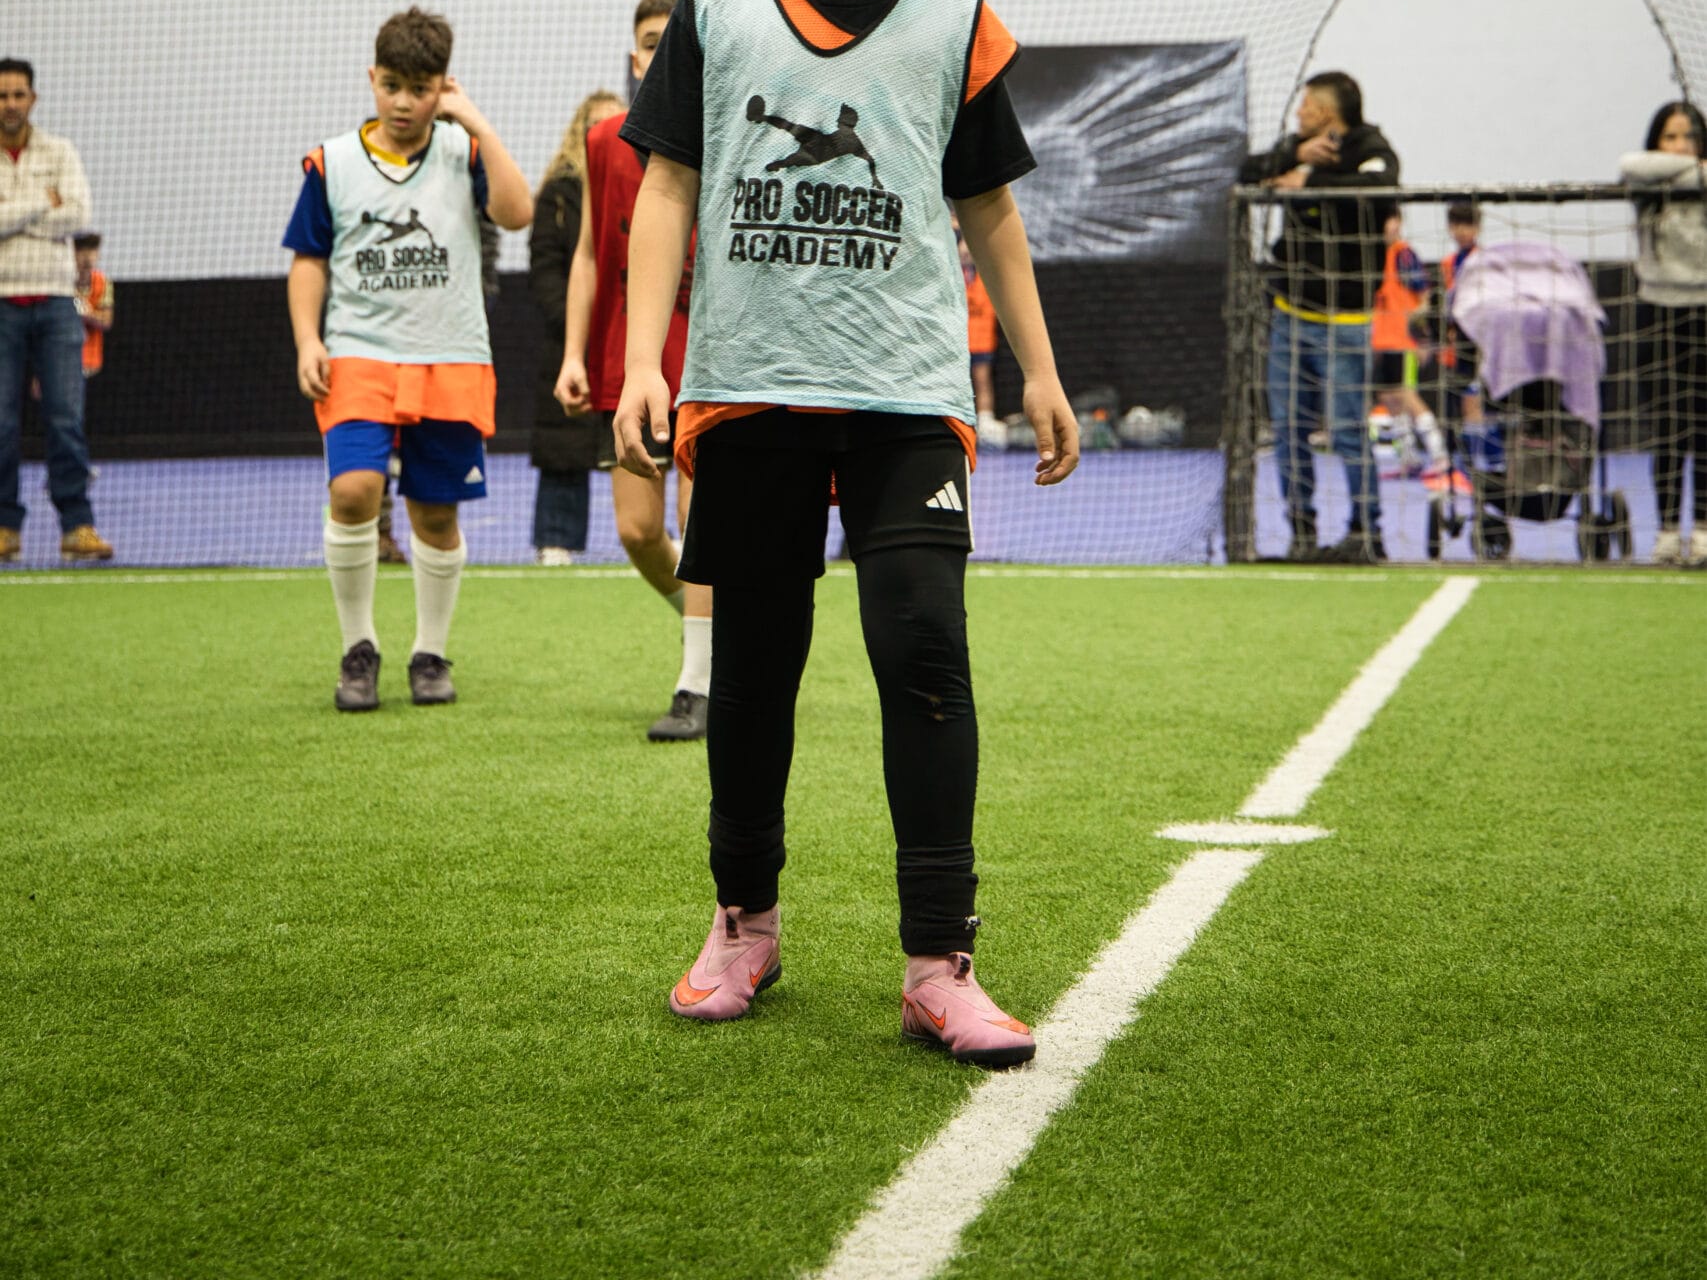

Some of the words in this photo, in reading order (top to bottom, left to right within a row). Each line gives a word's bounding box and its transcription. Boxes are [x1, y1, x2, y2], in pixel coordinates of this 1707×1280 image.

[731, 177, 783, 221] PRO
[793, 181, 903, 233] SOCCER
[356, 247, 386, 272] PRO
[392, 247, 448, 267] SOCCER
[728, 233, 900, 271] ACADEMY
[358, 274, 449, 293] ACADEMY
